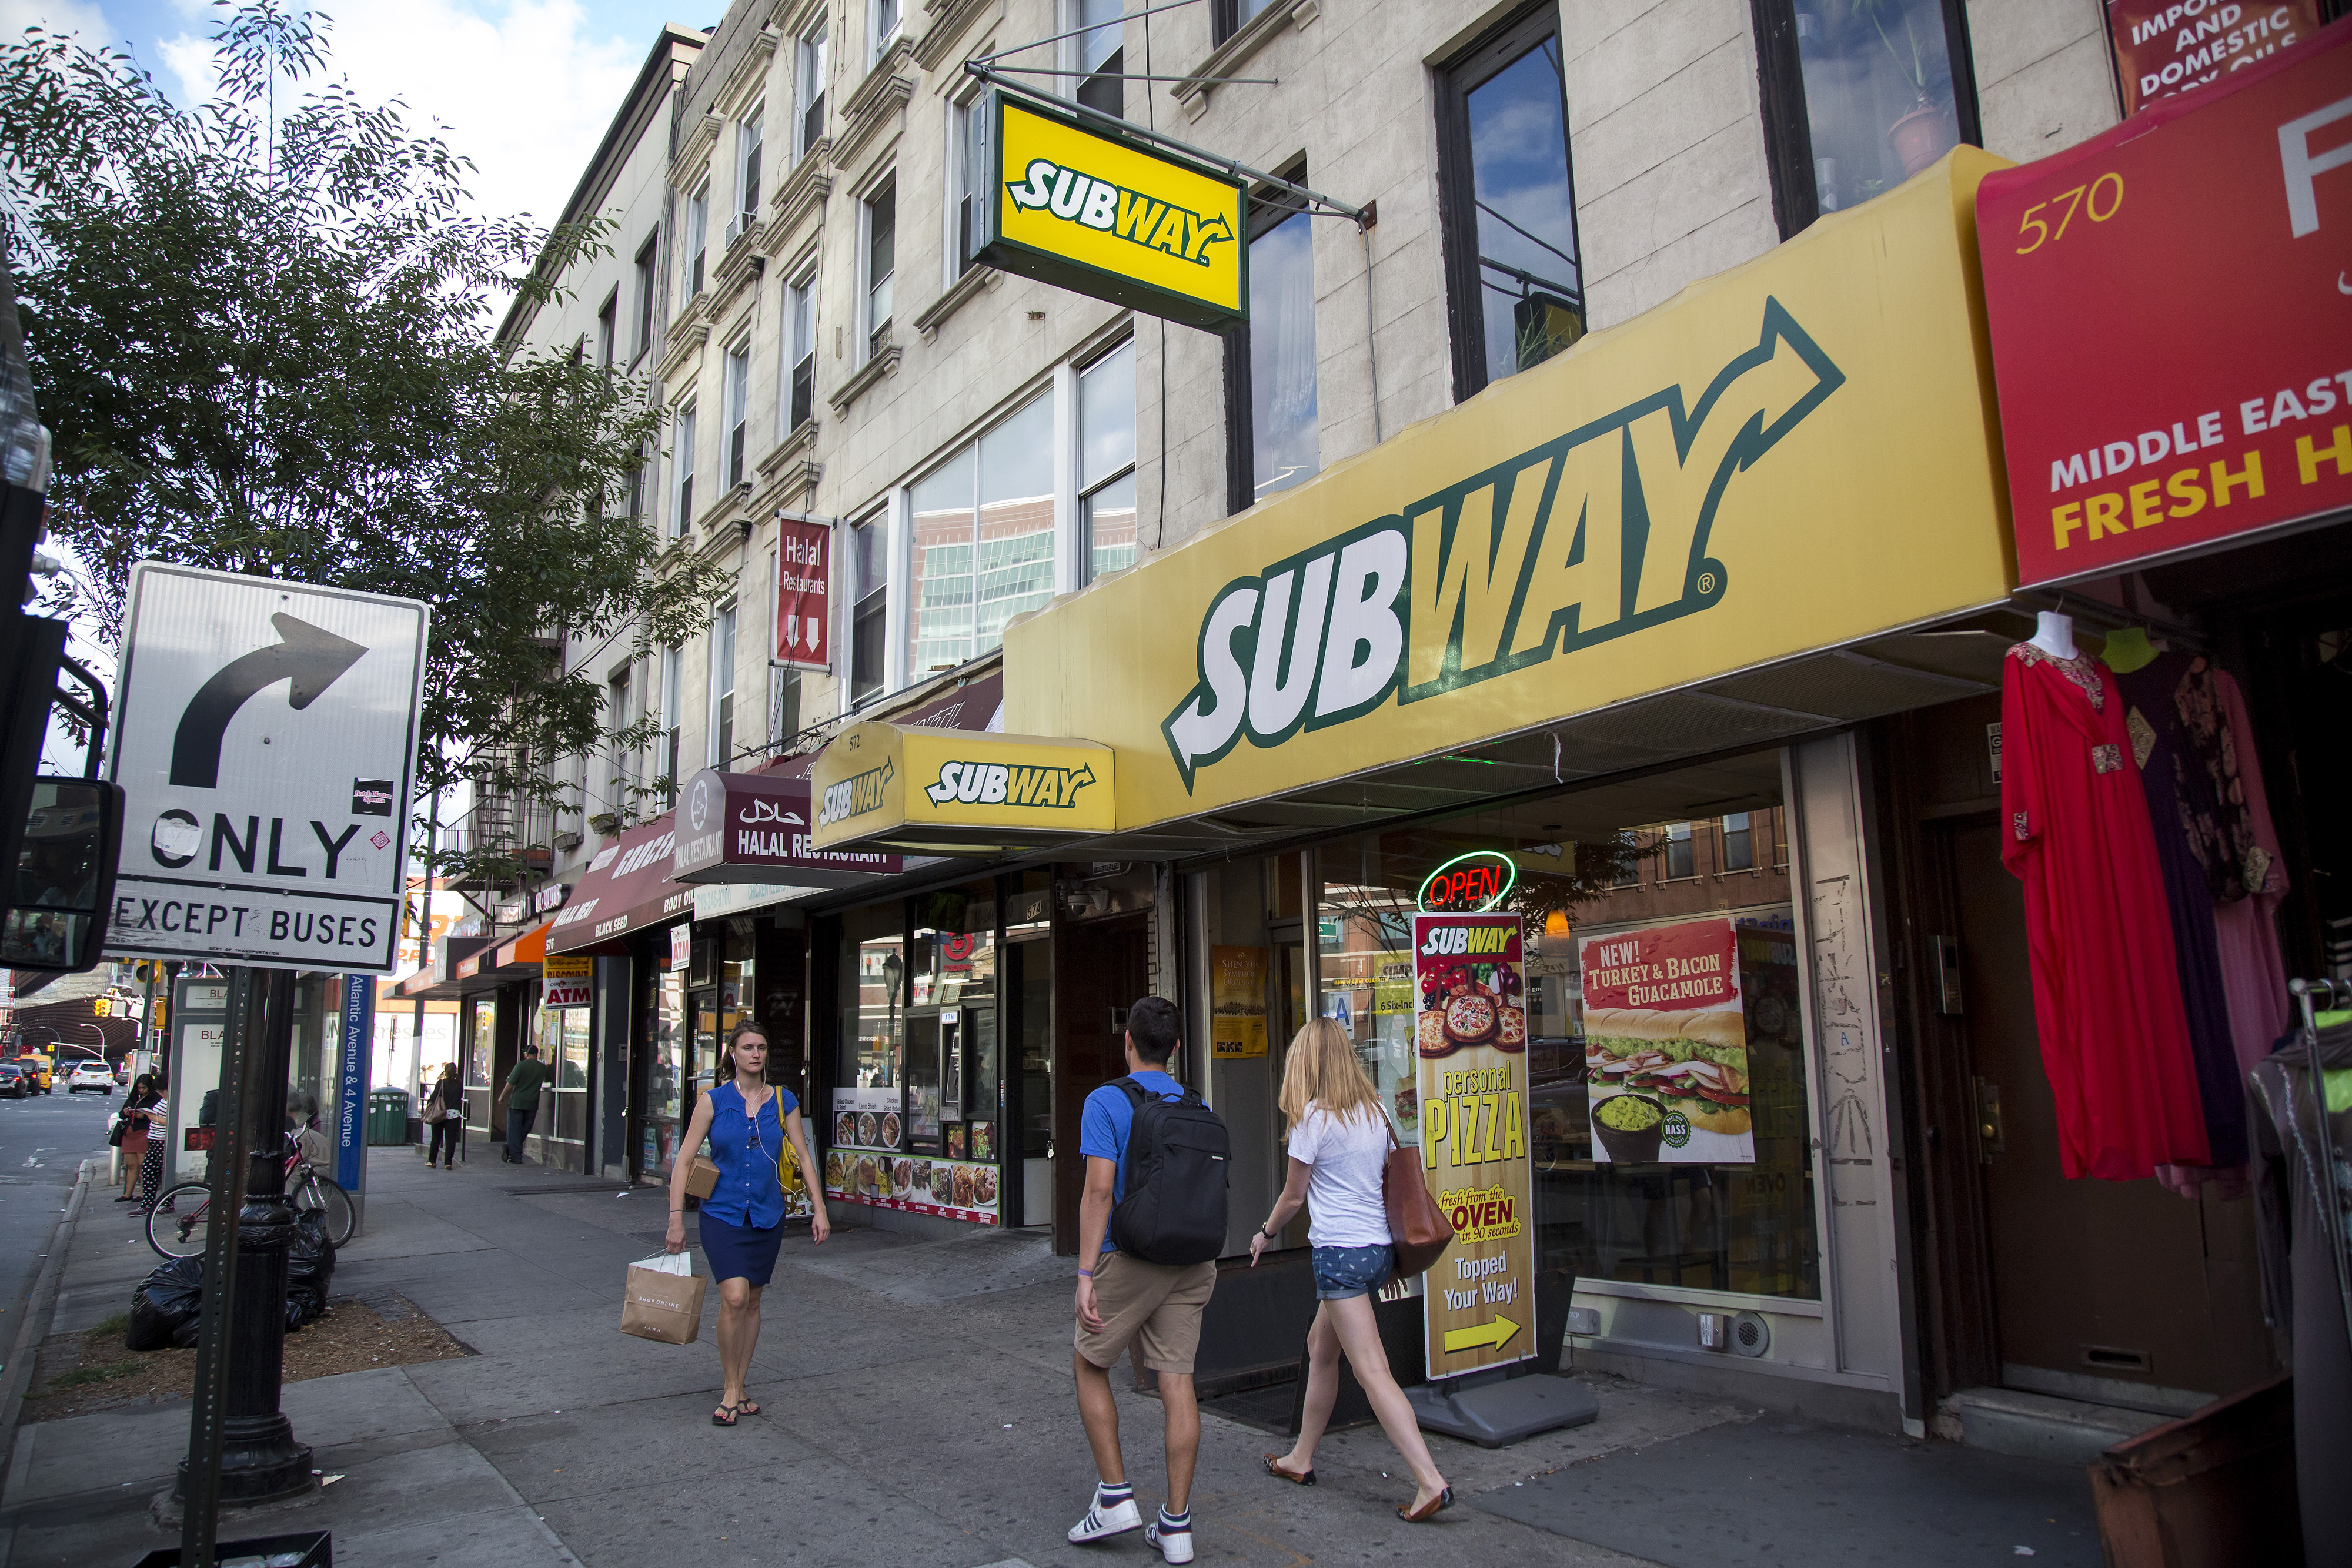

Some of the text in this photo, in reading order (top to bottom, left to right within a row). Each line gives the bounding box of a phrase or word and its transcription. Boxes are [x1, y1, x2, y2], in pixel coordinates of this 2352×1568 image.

[2175, 5, 2241, 53] AND
[2140, 6, 2290, 96] DOMESTIC
[1005, 159, 1234, 266] SUBWAY
[2015, 172, 2124, 255] 570
[2051, 411, 2224, 492] MIDDLE
[2051, 450, 2266, 550] FRESH
[786, 536, 821, 566] Halal
[1163, 296, 1844, 794] SUBWAY
[783, 571, 825, 595] Restaurants
[849, 734, 860, 751] 572
[372, 791, 392, 800] Master
[818, 757, 894, 832] SUBWAY
[925, 760, 1096, 808] SUBWAY
[739, 798, 804, 825] حلال
[151, 808, 362, 879] ONLY
[675, 830, 723, 870] HALAL RESTAURANT
[738, 830, 788, 857] HALAL
[748, 884, 769, 900] CHICKEN
[1430, 865, 1500, 905] OPEN
[552, 905, 580, 928] HALAL
[573, 898, 599, 922] MEAT
[664, 893, 683, 913] BODY
[1027, 901, 1041, 918] 574
[114, 897, 249, 937] EXCEPT
[270, 911, 377, 947] BUSES
[595, 915, 628, 938] BLACK SEED
[546, 938, 554, 951] 576
[673, 940, 689, 961] ATM
[1419, 922, 1519, 960] SUBWAY
[1600, 941, 1641, 968] NEW!
[1222, 959, 1243, 968] SHEN
[1589, 954, 1721, 991] TURKEY & BACON
[349, 976, 363, 1022] Atlantic
[546, 988, 591, 1004] ATM
[1381, 1002, 1385, 1011] 6
[1628, 977, 1723, 1007] GUACAMOLE
[1335, 998, 1350, 1026] A
[346, 1026, 360, 1072] Avenue
[1840, 1032, 1850, 1046] A
[345, 1076, 358, 1085] &
[1443, 1060, 1511, 1102] personal
[342, 1100, 356, 1147] Avenue
[1424, 1091, 1525, 1170] PIZZA
[1665, 1125, 1686, 1135] HASS
[1440, 1186, 1503, 1210] fresh from the
[1451, 1199, 1514, 1231] OVEN
[1462, 1221, 1518, 1241] in 90 seconds
[1455, 1251, 1506, 1282] Topped
[656, 1300, 679, 1308] ONLINE
[1444, 1277, 1518, 1310] Your Way!
